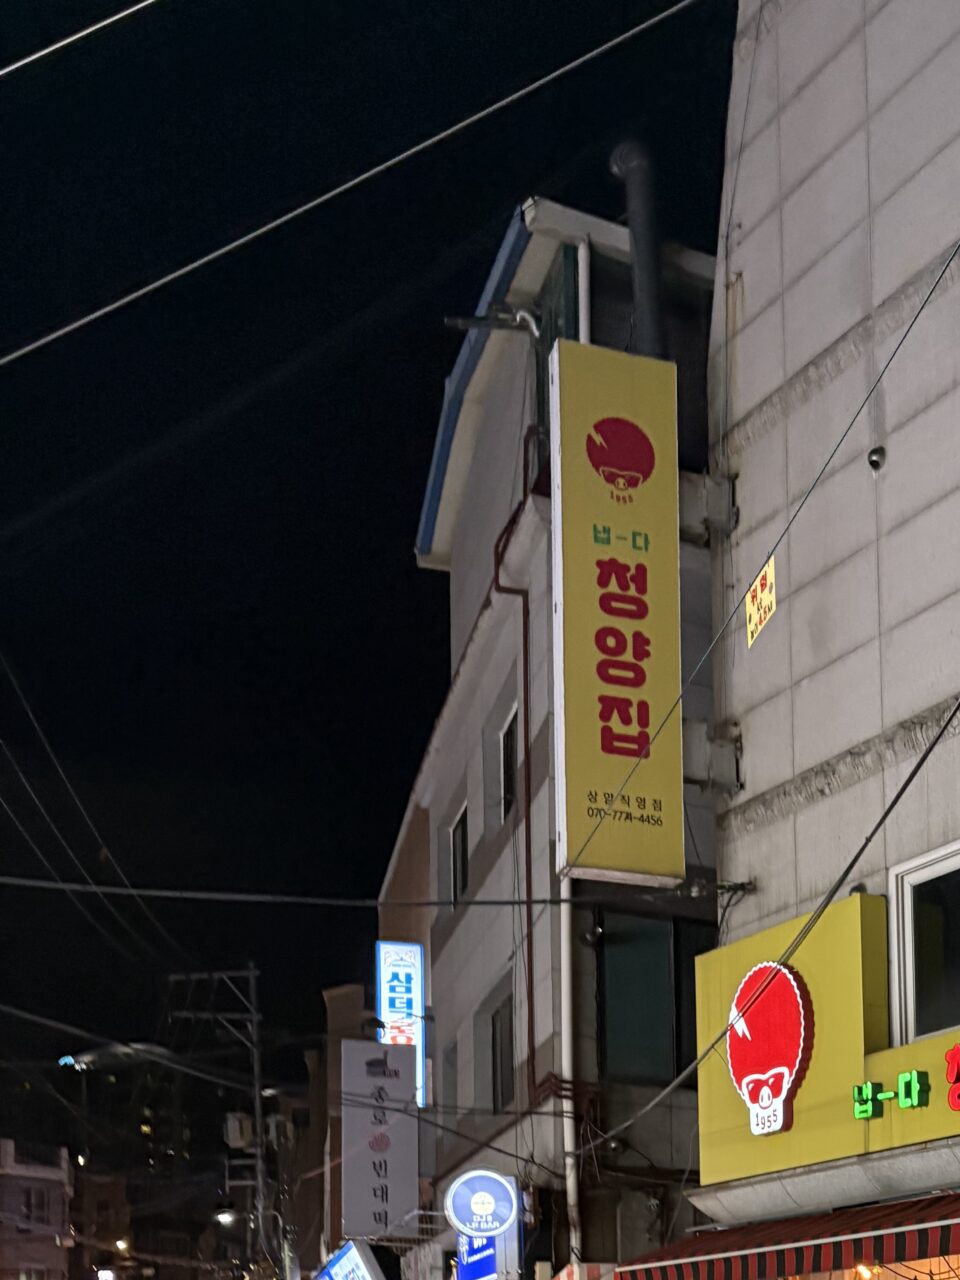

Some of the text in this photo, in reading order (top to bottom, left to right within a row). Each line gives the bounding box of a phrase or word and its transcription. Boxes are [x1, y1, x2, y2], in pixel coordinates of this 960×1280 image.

[594, 556, 651, 759] 청양집
[755, 1108, 778, 1130] 1955
[853, 1069, 926, 1120] 냅-다
